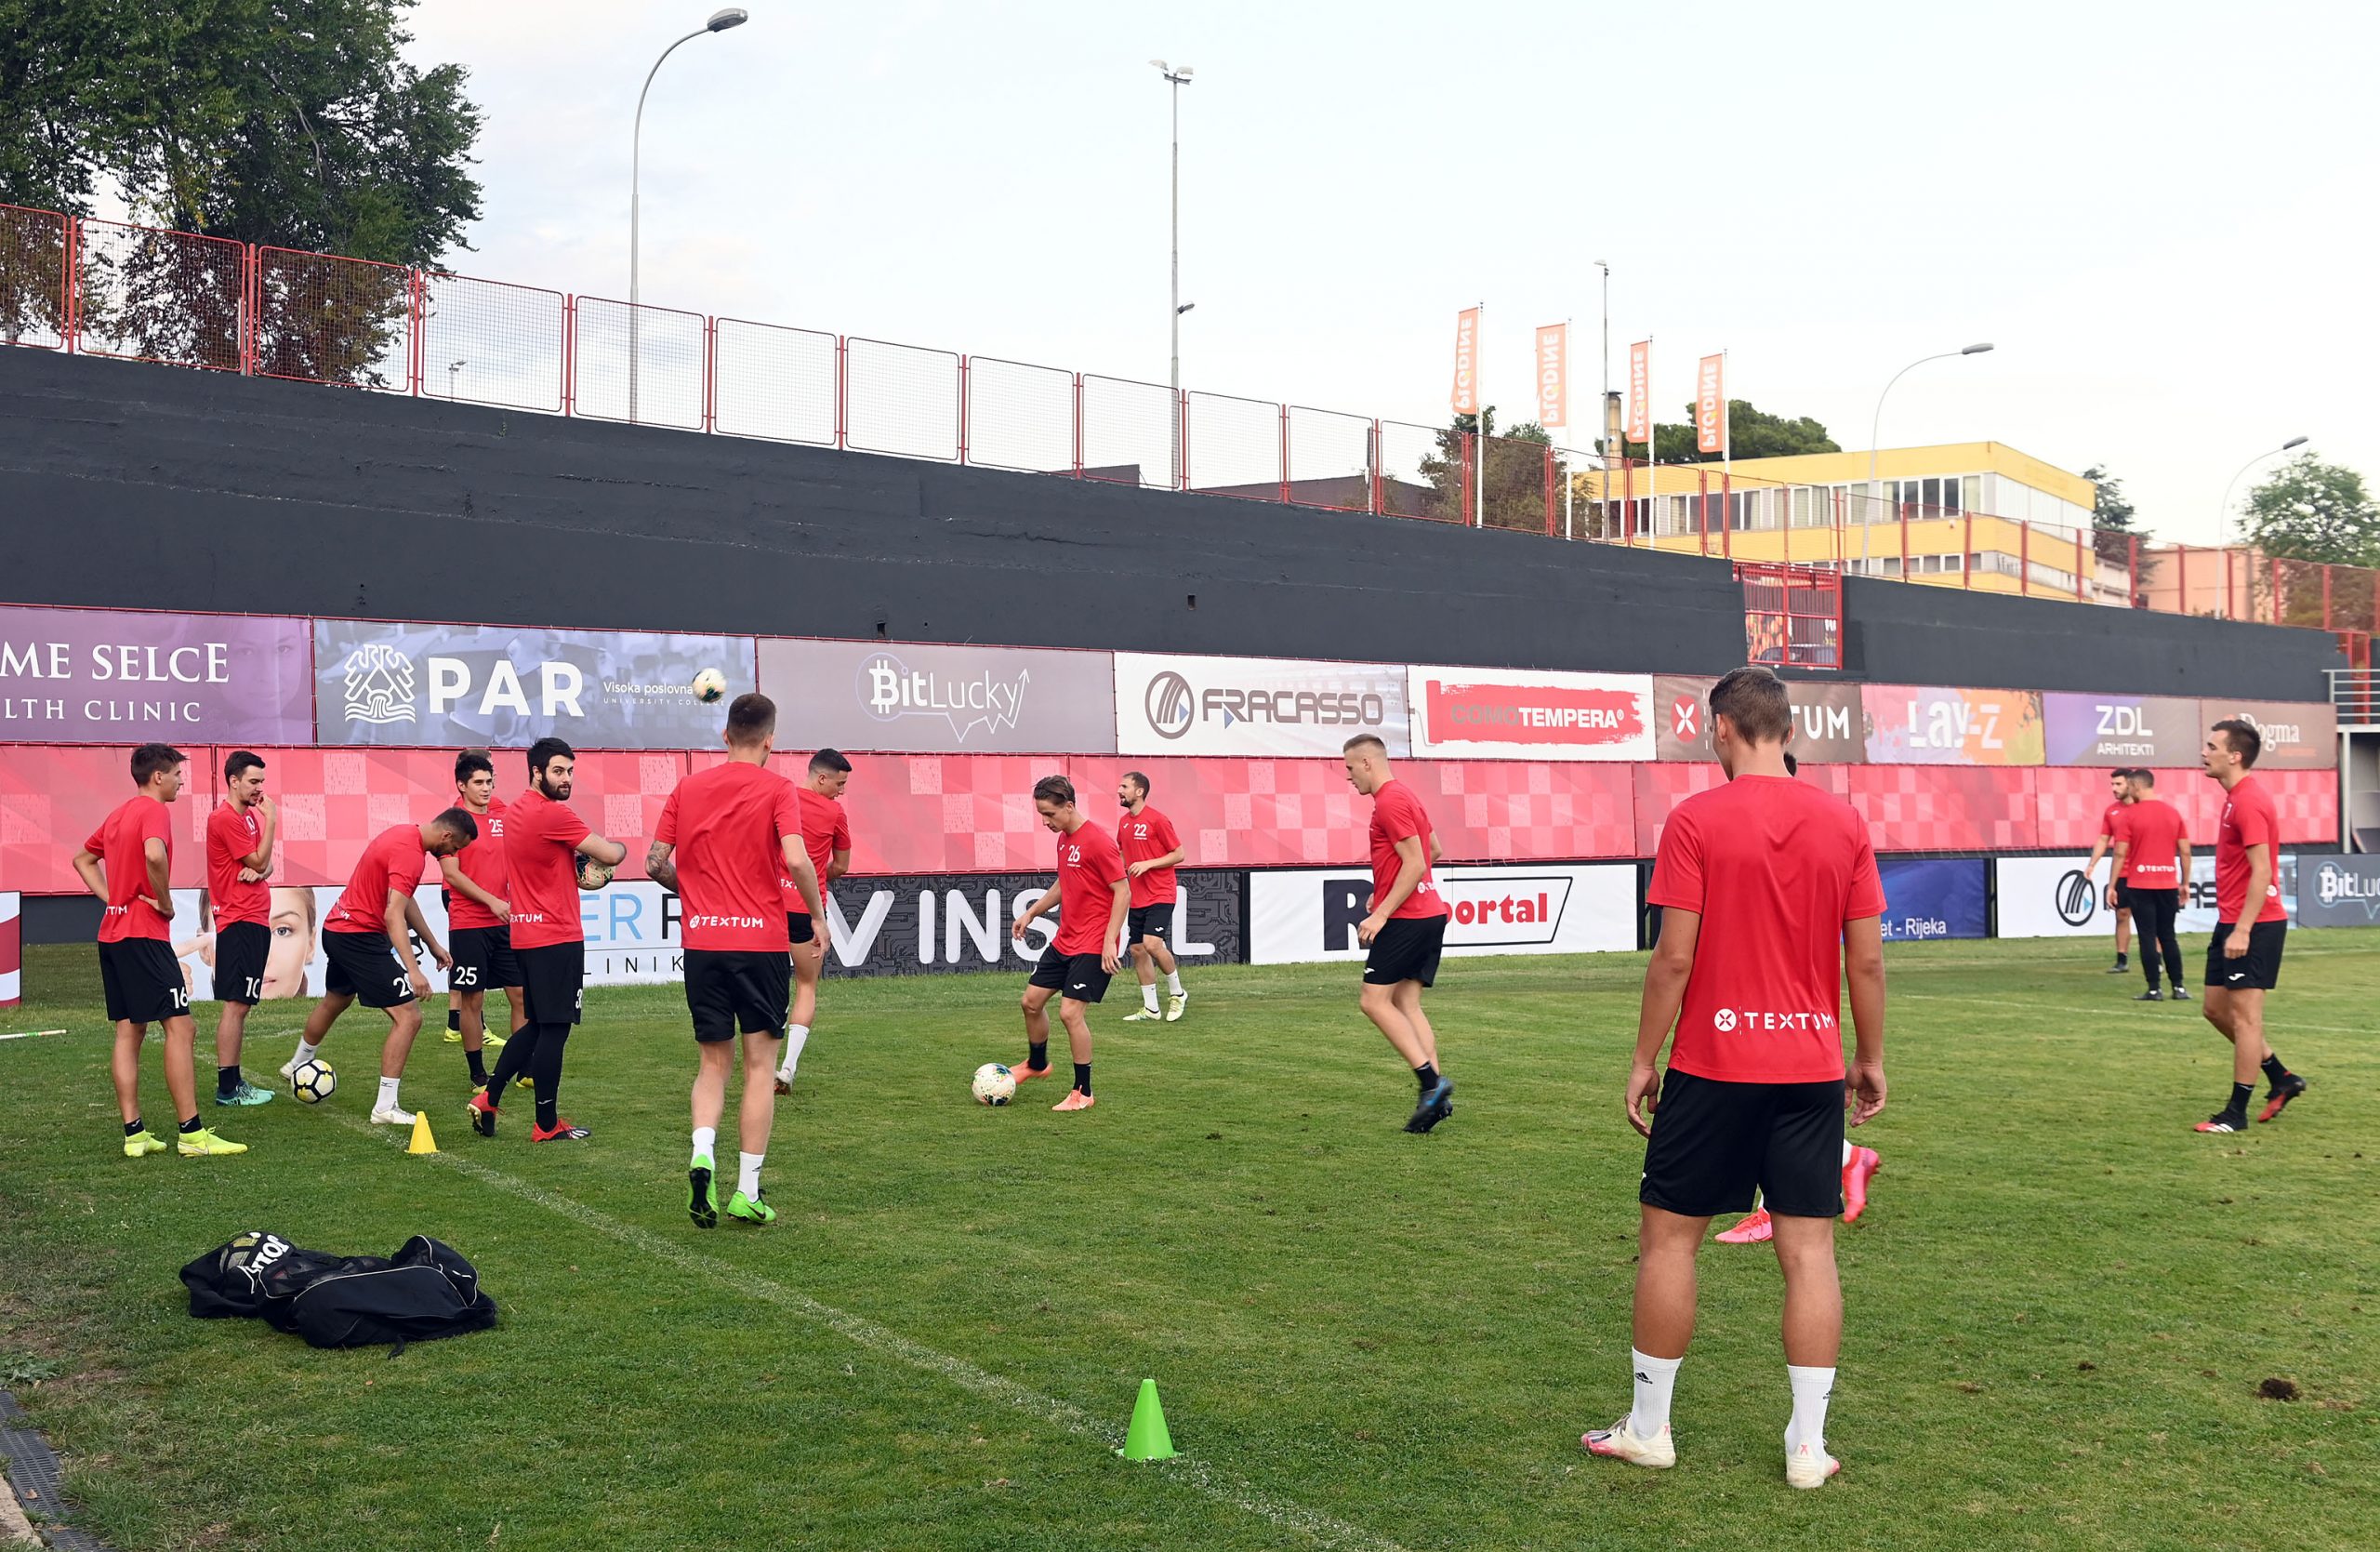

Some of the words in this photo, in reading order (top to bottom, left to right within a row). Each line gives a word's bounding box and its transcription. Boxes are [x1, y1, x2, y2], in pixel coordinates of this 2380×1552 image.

[91, 642, 230, 683] SELCE
[428, 657, 585, 717] PAR
[603, 682, 641, 694] Visoka
[643, 683, 694, 696] poslovna
[868, 659, 1019, 718] BitLucky
[84, 699, 201, 723] CLINIC
[603, 697, 670, 706] UNIVERSITY
[1202, 688, 1383, 726] FRACASSO
[2096, 705, 2153, 737] ZDL
[2096, 743, 2154, 757] ARHITEKTI
[1133, 823, 1147, 837] 22
[1067, 844, 1081, 863] 26
[701, 916, 764, 929] TEXTUM
[919, 884, 1216, 964] INSL
[1906, 917, 1947, 939] Rijeka
[454, 966, 478, 986] 25
[169, 987, 189, 1009] 16
